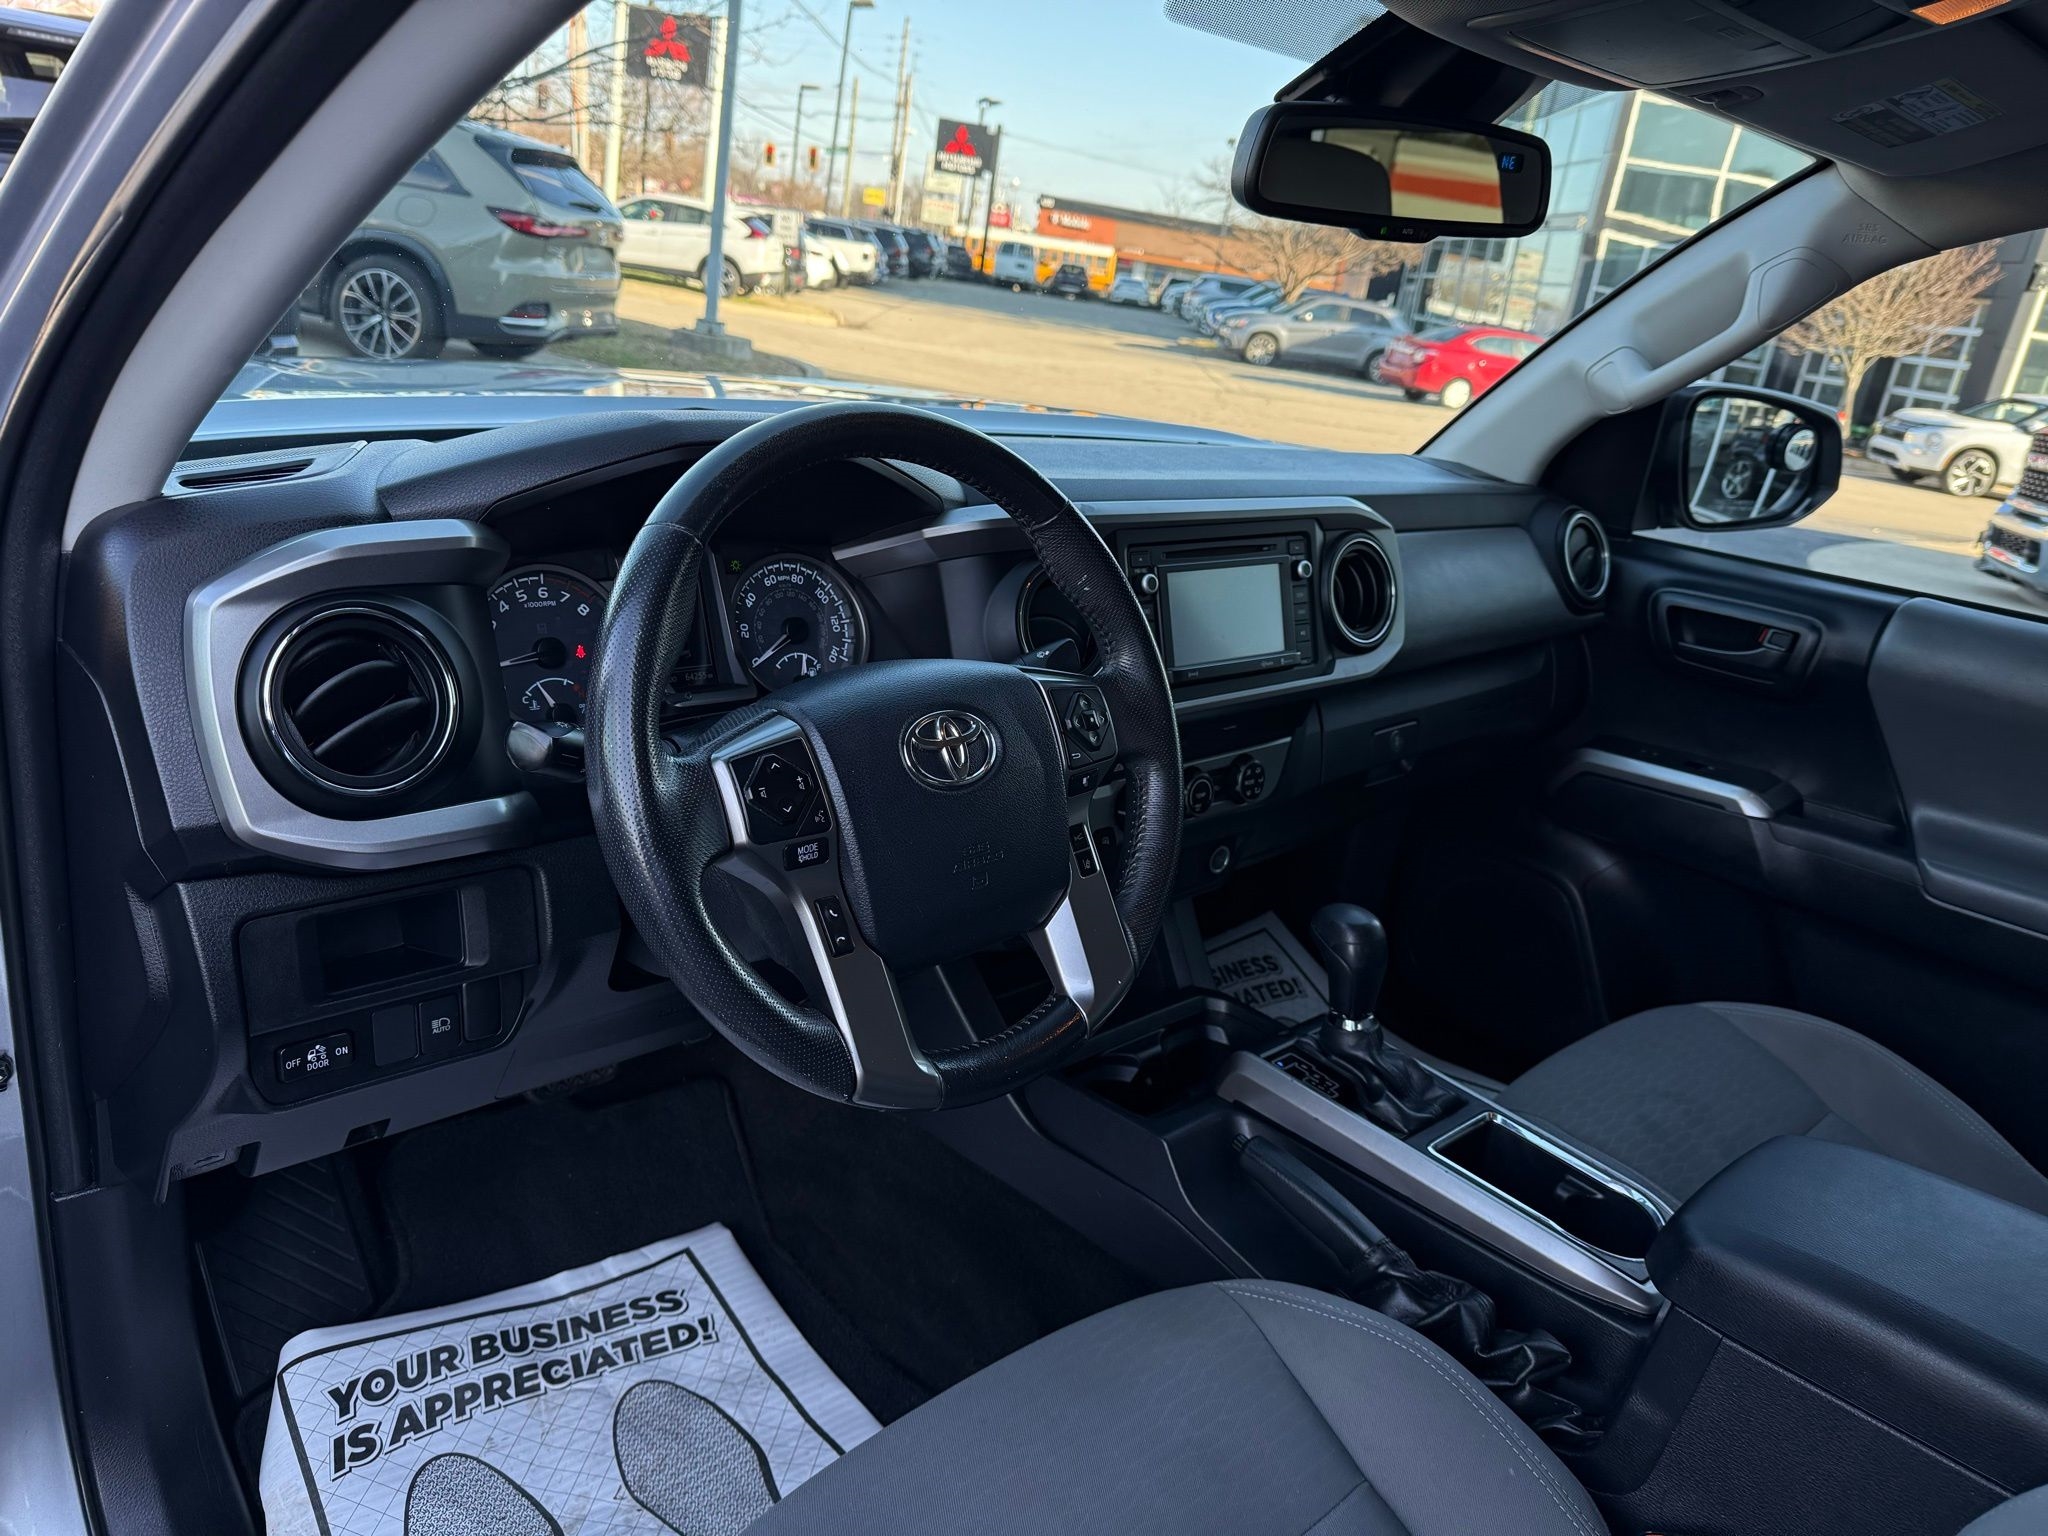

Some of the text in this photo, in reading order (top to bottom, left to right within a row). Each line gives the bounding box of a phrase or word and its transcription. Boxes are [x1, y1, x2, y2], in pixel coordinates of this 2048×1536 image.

[1501, 155, 1517, 170] NE
[763, 574, 777, 587] 60
[790, 573, 804, 585] 80
[515, 589, 528, 603] 5
[537, 586, 549, 599] 6
[559, 590, 571, 603] 7
[814, 586, 829, 605] 100
[499, 600, 510, 614] 4
[744, 592, 757, 608] 40
[576, 603, 590, 616] 8
[739, 623, 750, 639] 20
[829, 615, 841, 633] 120
[828, 645, 840, 663] 140
[522, 695, 529, 704] C
[797, 842, 819, 855] MODE
[1210, 954, 1282, 986] SINESS
[432, 1024, 451, 1035] AUTO
[335, 1045, 349, 1057] ON
[285, 1057, 302, 1070] OFF
[306, 1058, 330, 1072] DOOR
[324, 1288, 688, 1424] YOUR BUSINESS
[330, 1314, 719, 1479] IS APPRECIATED!
